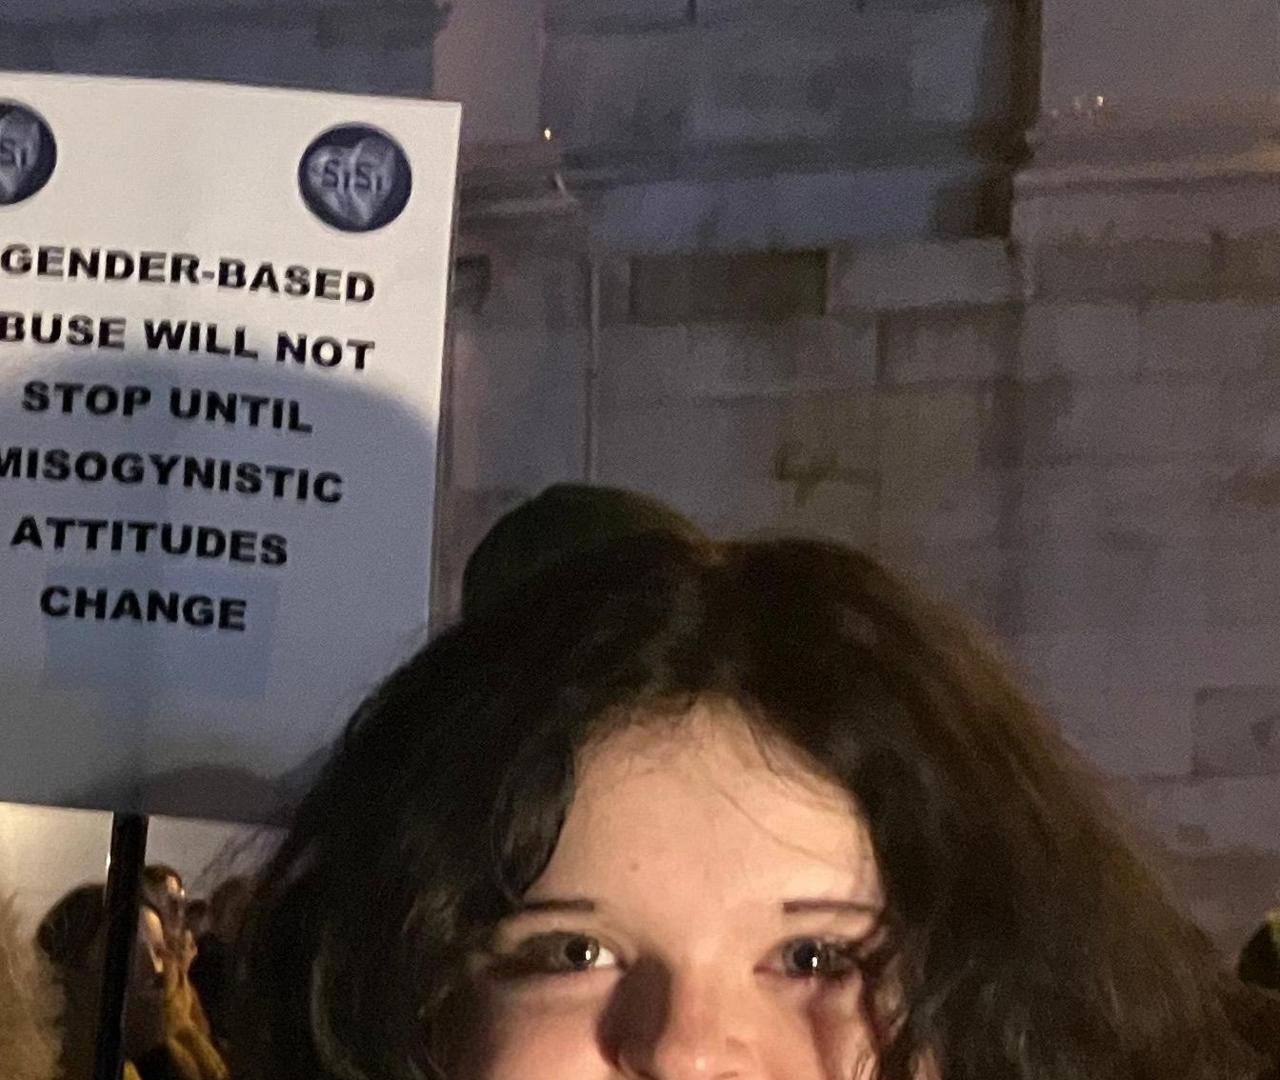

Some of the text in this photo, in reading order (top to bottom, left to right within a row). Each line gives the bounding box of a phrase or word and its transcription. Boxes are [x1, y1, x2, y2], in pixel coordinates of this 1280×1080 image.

[0, 244, 375, 303] GENDER-BASED
[144, 321, 258, 361] WILL
[276, 332, 375, 370] NOT
[21, 382, 312, 433] STOP UNTIL
[11, 517, 288, 566] ATTITUDES
[40, 585, 247, 631] CHANGE
